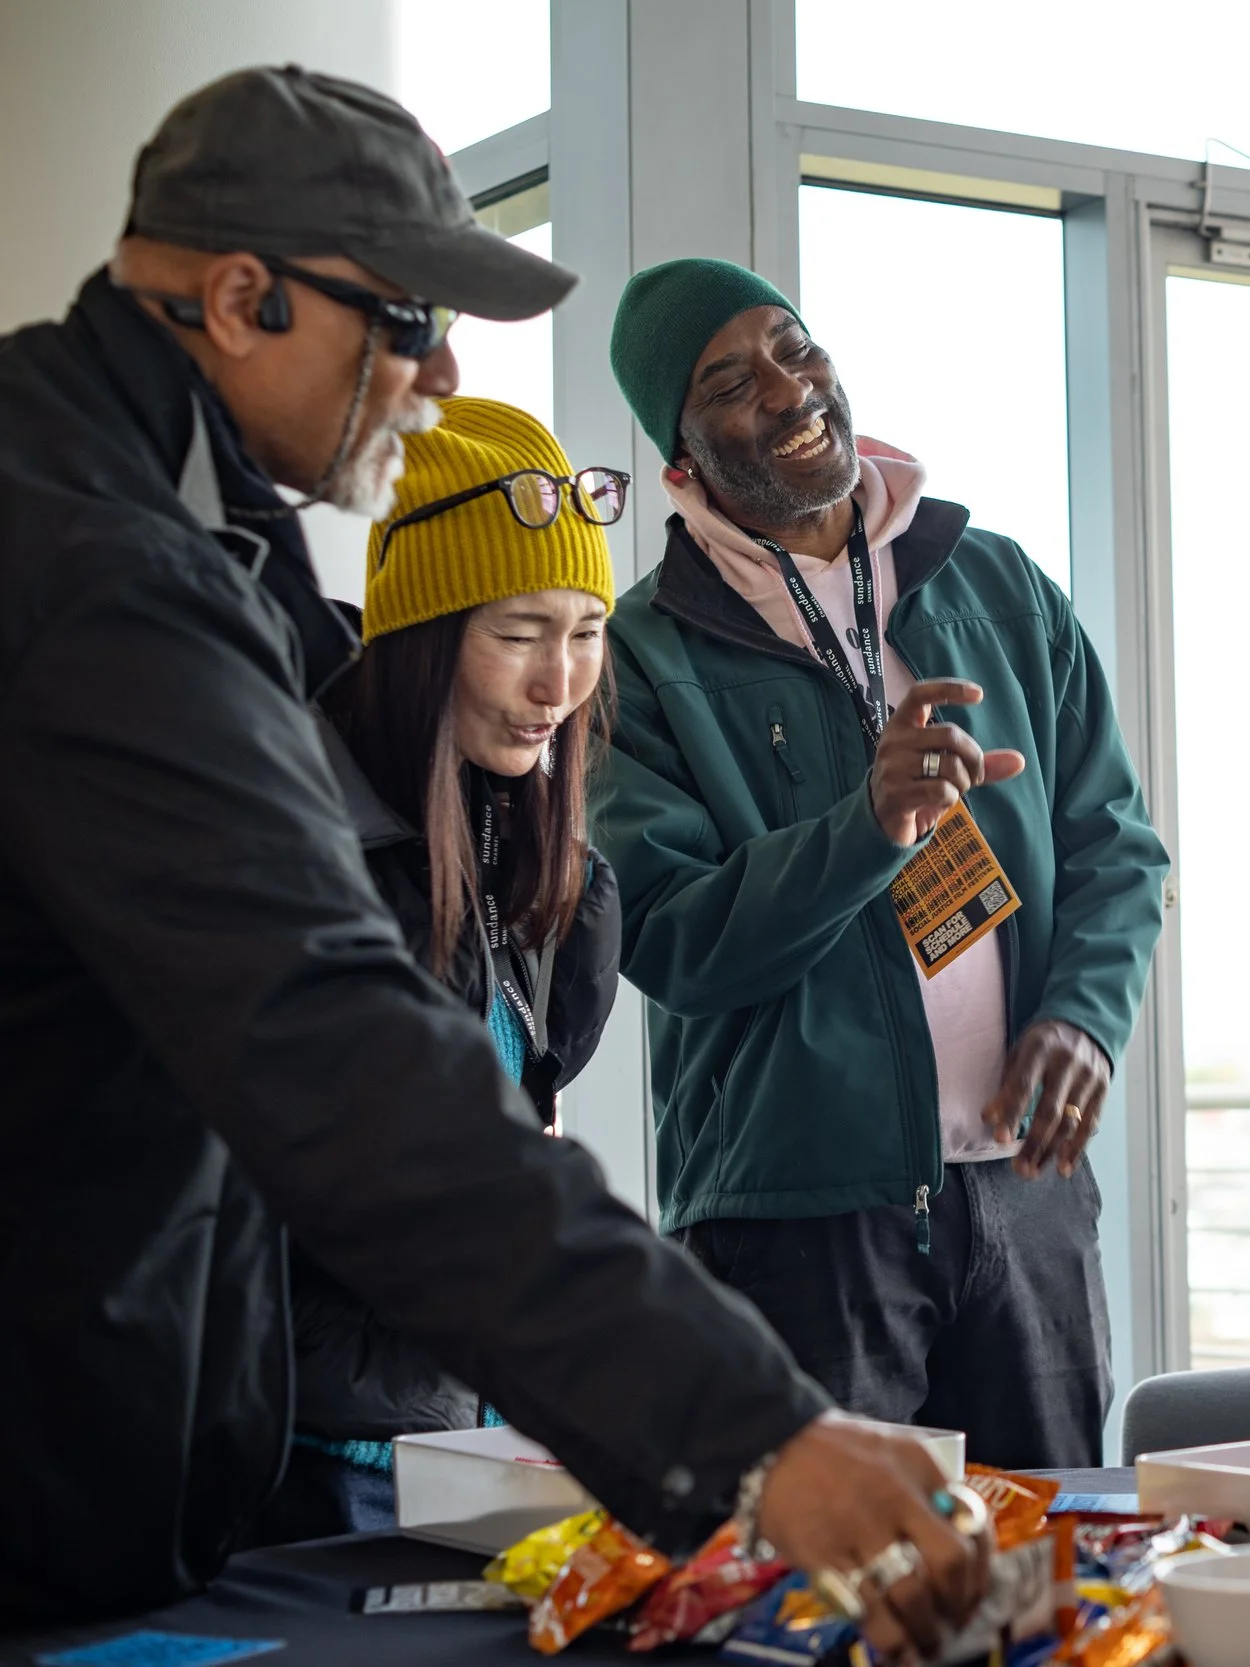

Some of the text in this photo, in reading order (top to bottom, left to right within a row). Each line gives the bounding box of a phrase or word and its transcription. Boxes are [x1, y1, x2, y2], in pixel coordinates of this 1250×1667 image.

[790, 577, 818, 623] sundance
[853, 557, 864, 605] sundance
[810, 596, 826, 618] CHANNEL
[862, 628, 876, 675] sundance
[482, 804, 492, 864] sundance
[889, 877, 907, 894] OCIAL
[907, 859, 930, 880] JUSTICE
[910, 864, 933, 885] JUSTICE
[921, 883, 945, 905] JUSTICE
[486, 894, 499, 949] sundance
[909, 916, 930, 936] SOCIAL
[930, 898, 953, 919] JUSTICE
[953, 886, 967, 900] FILM
[967, 864, 994, 888] FESTIVAL
[921, 924, 947, 948] SCAN
[945, 909, 964, 929] FOR
[924, 915, 969, 955] SCHEDULE
[928, 942, 948, 961] AND
[946, 922, 973, 947] MORE
[502, 980, 536, 1036] sundance
